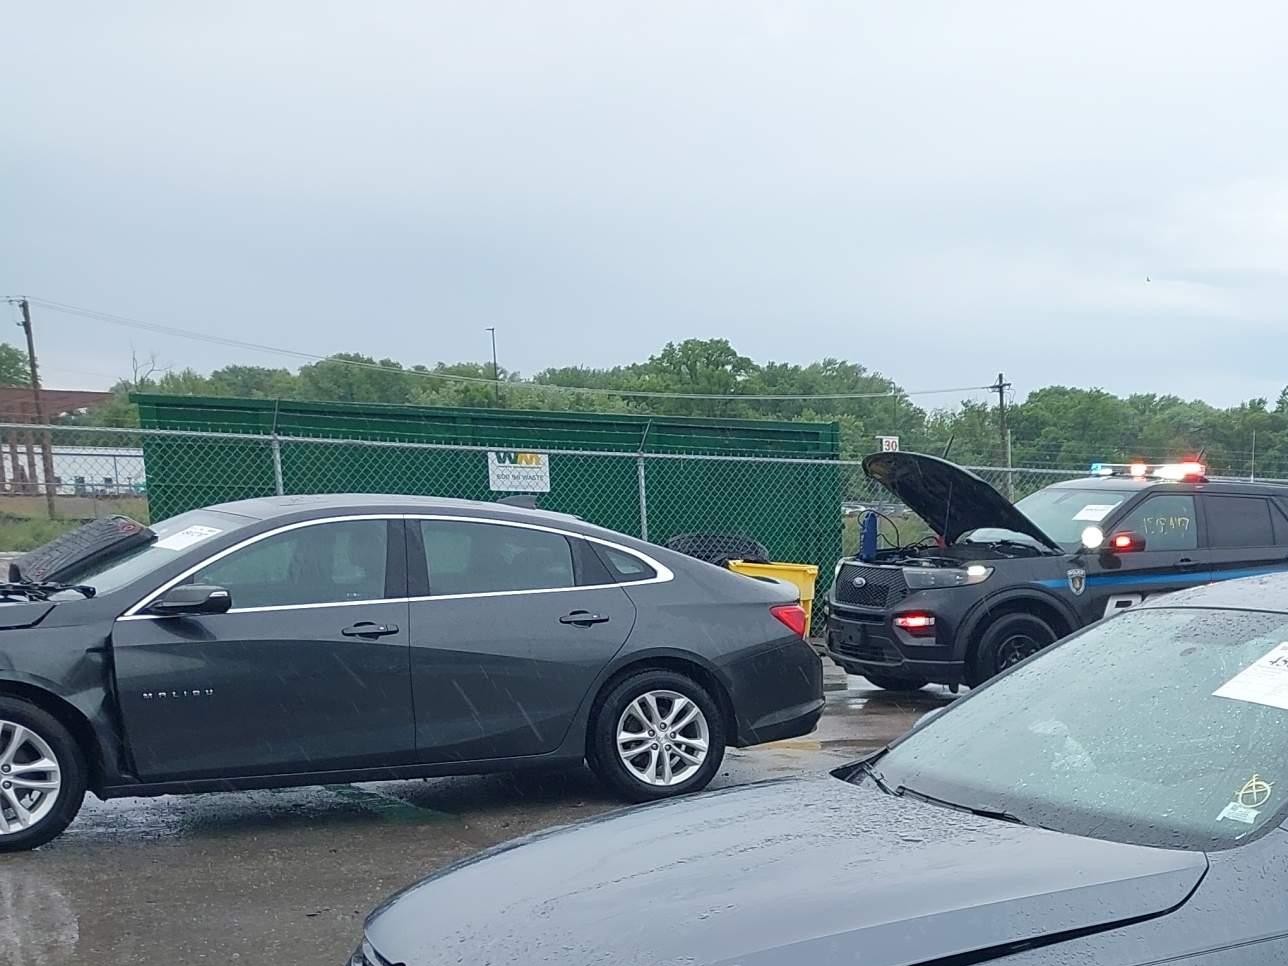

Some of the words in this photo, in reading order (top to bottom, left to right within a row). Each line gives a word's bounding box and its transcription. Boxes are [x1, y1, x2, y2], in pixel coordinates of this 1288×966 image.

[884, 440, 898, 451] 30
[496, 451, 541, 465] WM
[142, 688, 214, 699] MALIBU
